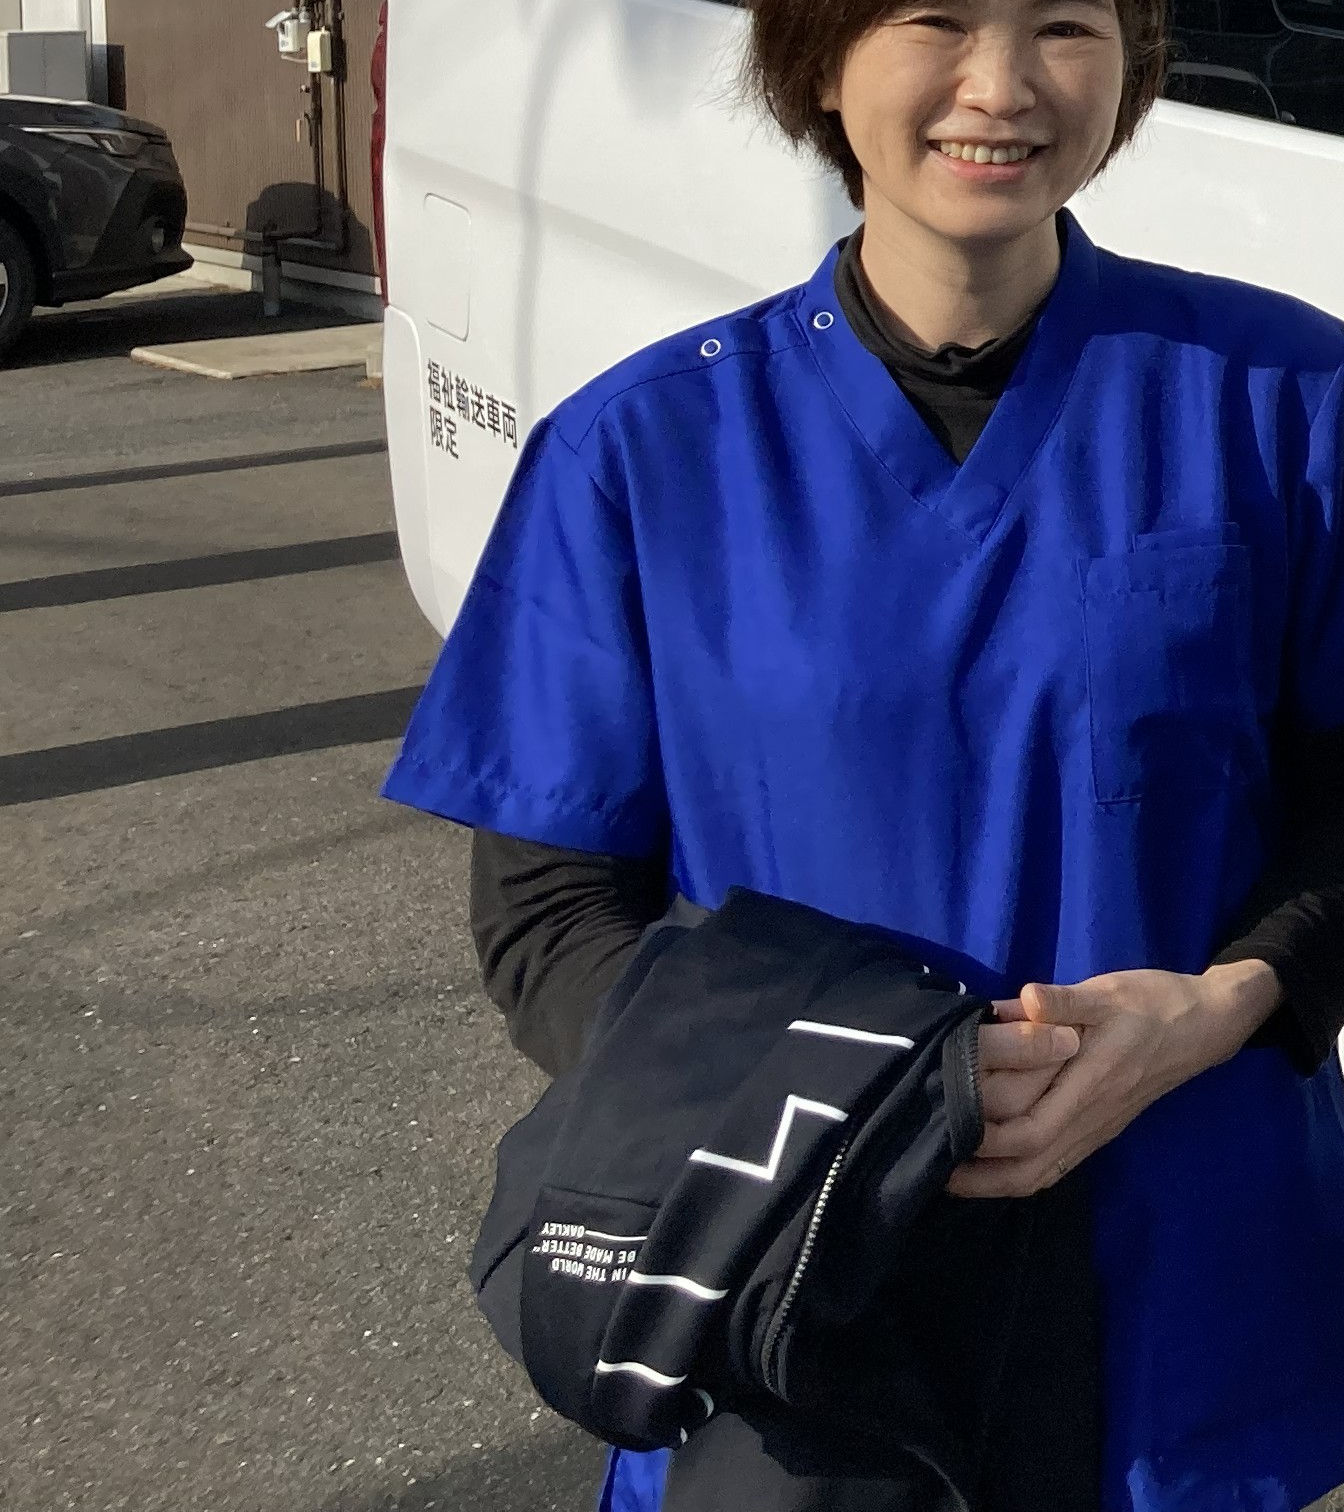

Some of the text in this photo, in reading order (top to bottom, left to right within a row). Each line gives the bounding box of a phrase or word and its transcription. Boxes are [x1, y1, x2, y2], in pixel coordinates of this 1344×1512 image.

[427, 357, 518, 449] 福祉輸送車両
[429, 404, 459, 460] 限定
[541, 1222, 585, 1238] OAKLEY
[584, 1244, 614, 1264] MADE
[551, 1257, 628, 1282] IN THE WORLD
